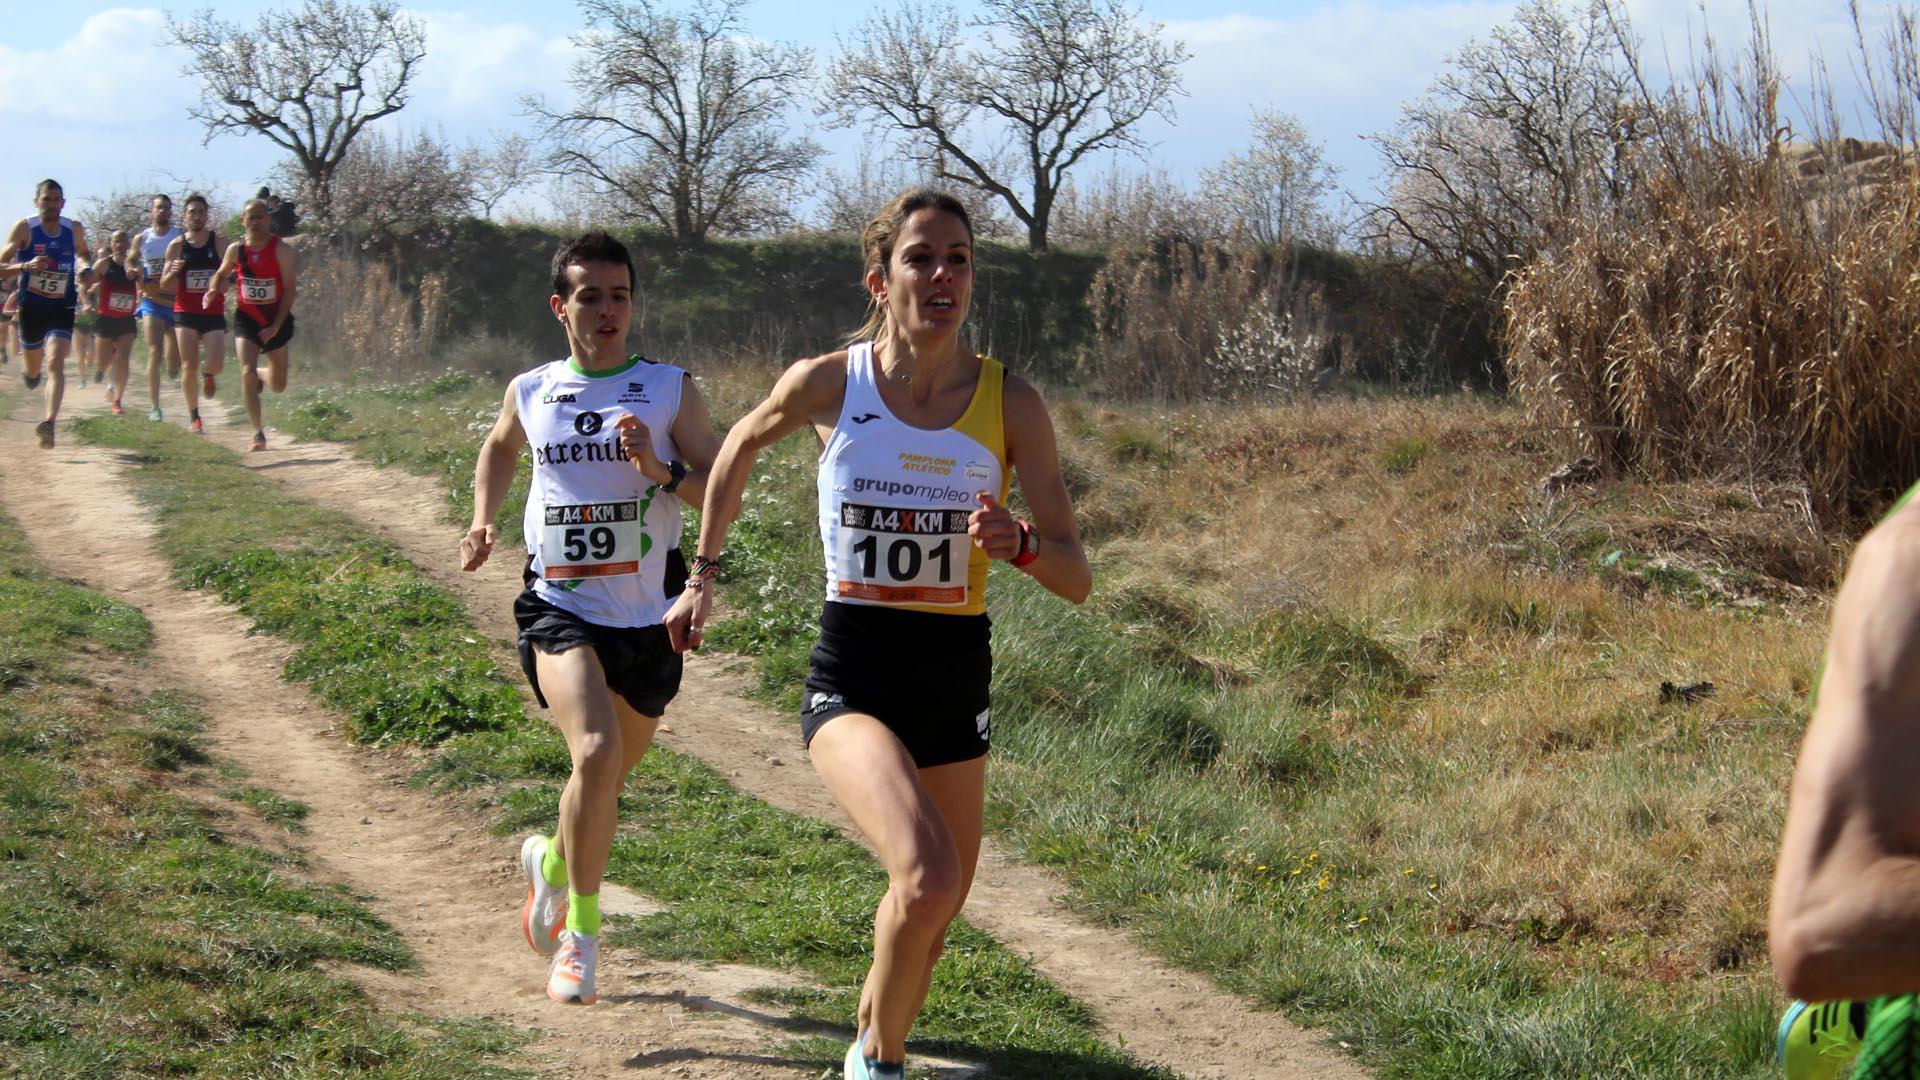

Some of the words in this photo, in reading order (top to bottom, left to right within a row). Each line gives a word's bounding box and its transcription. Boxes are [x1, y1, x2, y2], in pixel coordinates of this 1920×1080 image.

[39, 279, 58, 291] 15
[193, 277, 209, 287] 77
[249, 287, 267, 298] 30
[898, 452, 957, 467] PAMPLONA
[853, 477, 969, 502] grupompleo
[562, 504, 615, 524] A4XKM
[870, 509, 943, 533] A4XKM
[563, 527, 616, 562] 59
[853, 535, 951, 583] 101
